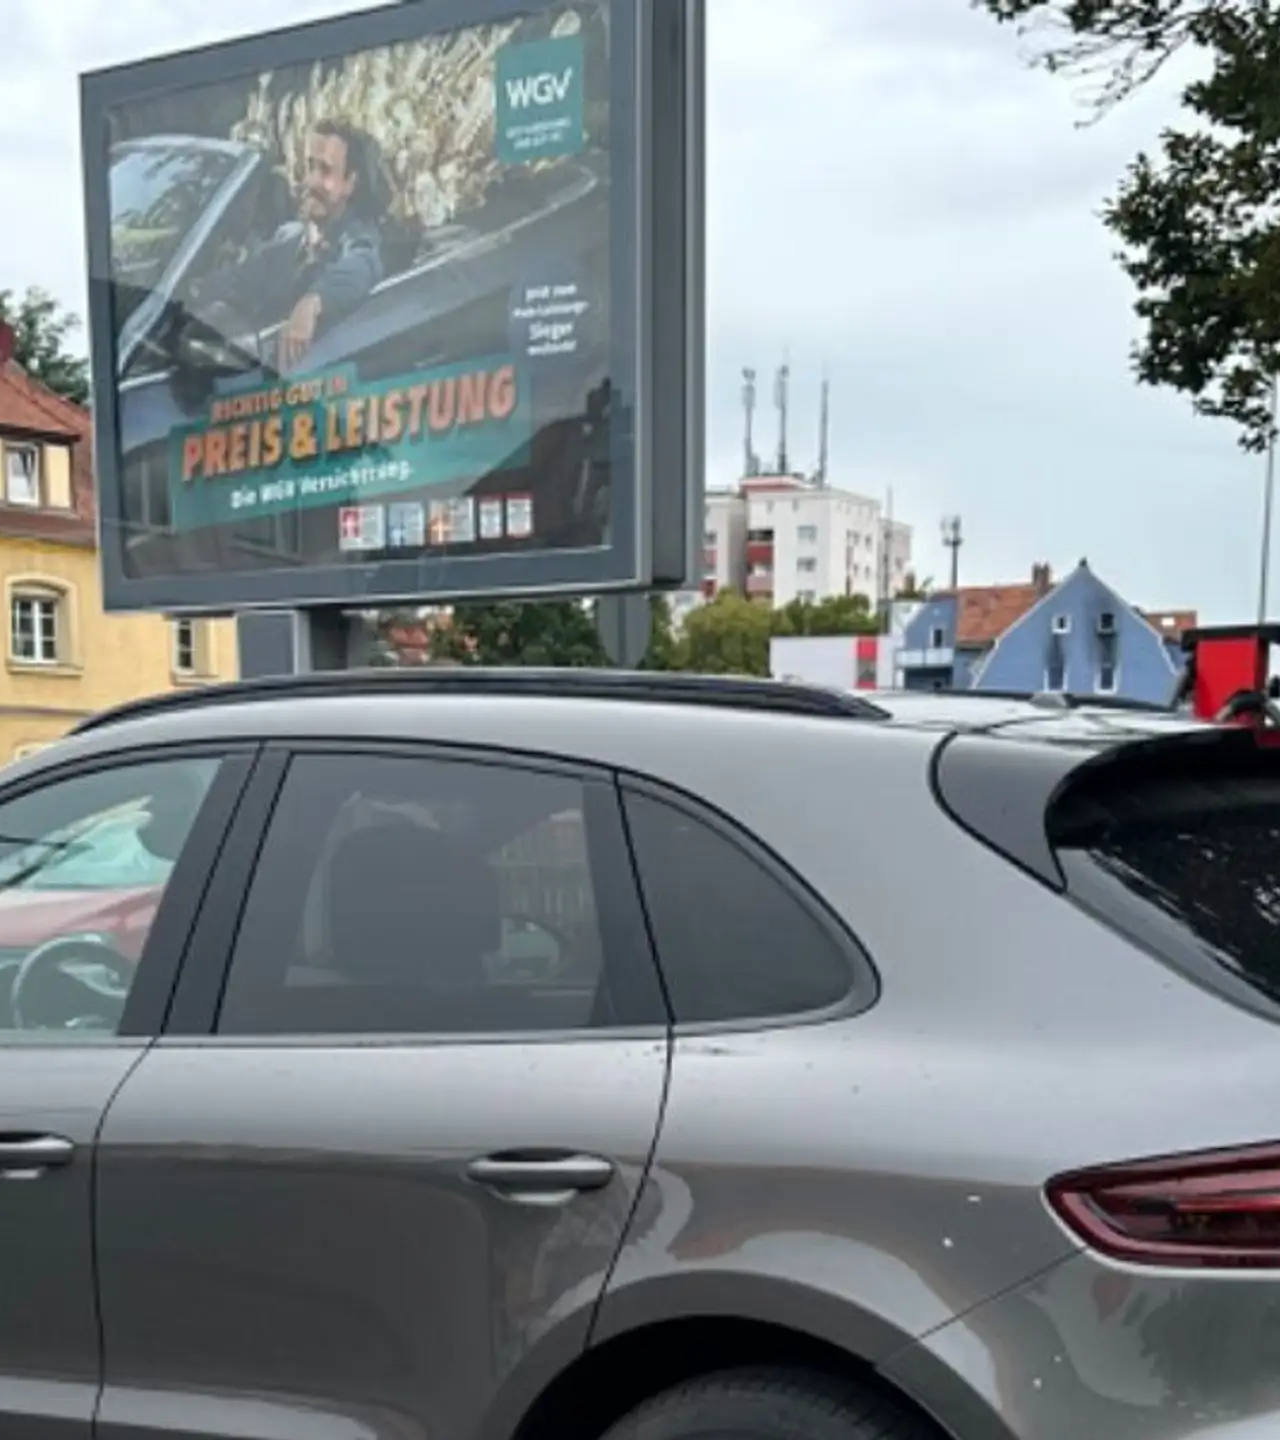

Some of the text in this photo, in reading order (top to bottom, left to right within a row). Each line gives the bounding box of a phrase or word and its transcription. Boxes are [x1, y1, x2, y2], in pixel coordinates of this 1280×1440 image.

[505, 67, 572, 109] WGV
[181, 364, 517, 483] PREIS & LEISTUNG
